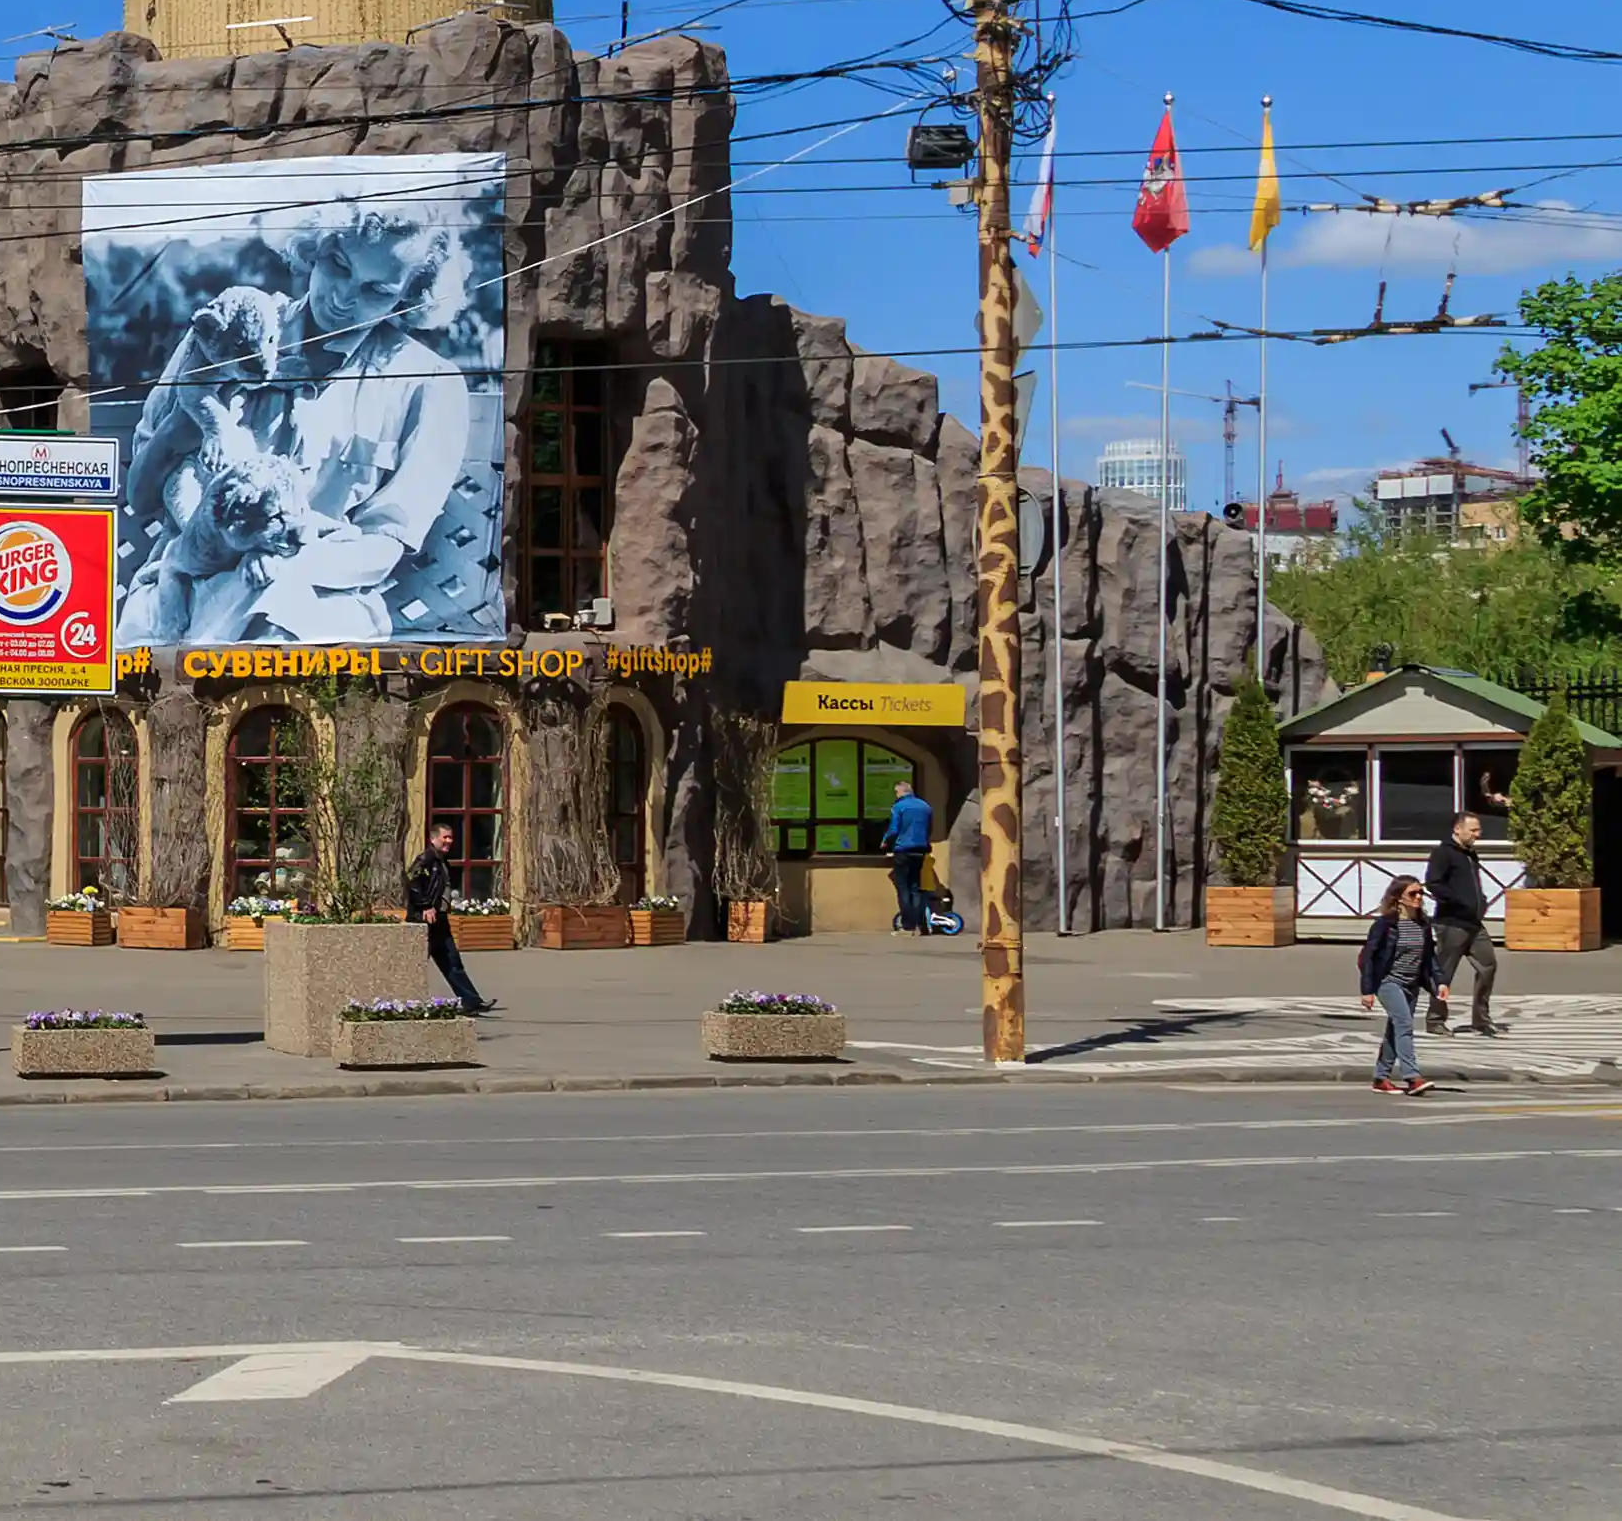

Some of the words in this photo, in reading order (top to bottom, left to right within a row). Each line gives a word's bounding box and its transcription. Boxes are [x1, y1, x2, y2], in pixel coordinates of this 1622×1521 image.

[69, 622, 97, 647] 24
[183, 648, 381, 679] СУВЕНИРЫ
[419, 648, 491, 677] GIFT
[498, 648, 584, 678] SHOP
[606, 644, 713, 679] #giftshop#
[38, 677, 90, 688] ЗООПАРКЕ
[817, 693, 874, 711] Кассы
[880, 695, 933, 712] Tickets
